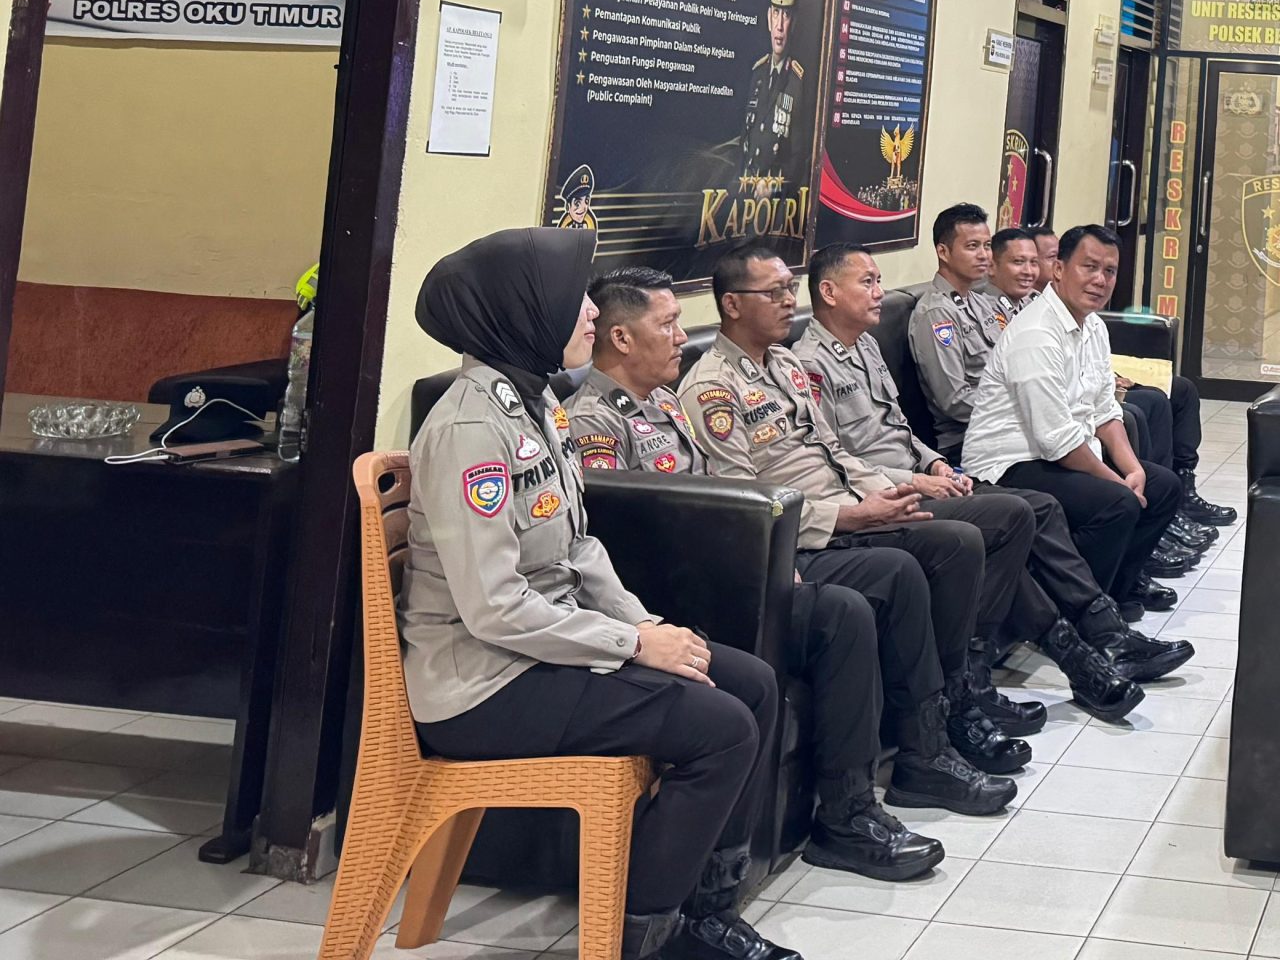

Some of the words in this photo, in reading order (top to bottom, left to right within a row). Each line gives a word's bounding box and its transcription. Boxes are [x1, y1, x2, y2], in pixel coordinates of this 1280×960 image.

[76, 2, 177, 22] POLRES
[187, 4, 243, 24] OKU
[251, 6, 340, 26] TIMUR
[594, 8, 641, 26] Pemantapan
[641, 15, 681, 31] Komunikasi
[681, 22, 701, 34] Publik
[679, 2, 700, 15] Publik
[700, 6, 713, 17] Polri
[713, 8, 727, 22] Yang
[727, 11, 758, 26] Terintegrasi
[1191, 0, 1226, 18] UNIT
[592, 29, 639, 45] Pengawasan
[639, 35, 673, 52] Pimpinan
[673, 41, 693, 53] Dalam
[693, 44, 711, 56] Setiap
[711, 46, 735, 60] Kegiatan
[1209, 24, 1262, 43] POLSEK
[590, 50, 631, 67] Penguatan
[631, 56, 656, 70] Fungsi
[656, 59, 695, 73] Pengawasan
[588, 72, 635, 88] Pengawasan
[635, 77, 652, 89] Oleh
[653, 80, 688, 93] Masyarakat
[688, 83, 710, 94] Pencari
[710, 85, 734, 97] Keadilan
[587, 90, 613, 104] (Public
[614, 92, 653, 107] Complaint)
[699, 186, 809, 244] KAPOLRI
[1157, 121, 1186, 317] RESKRIM
[511, 465, 542, 493] TRI
